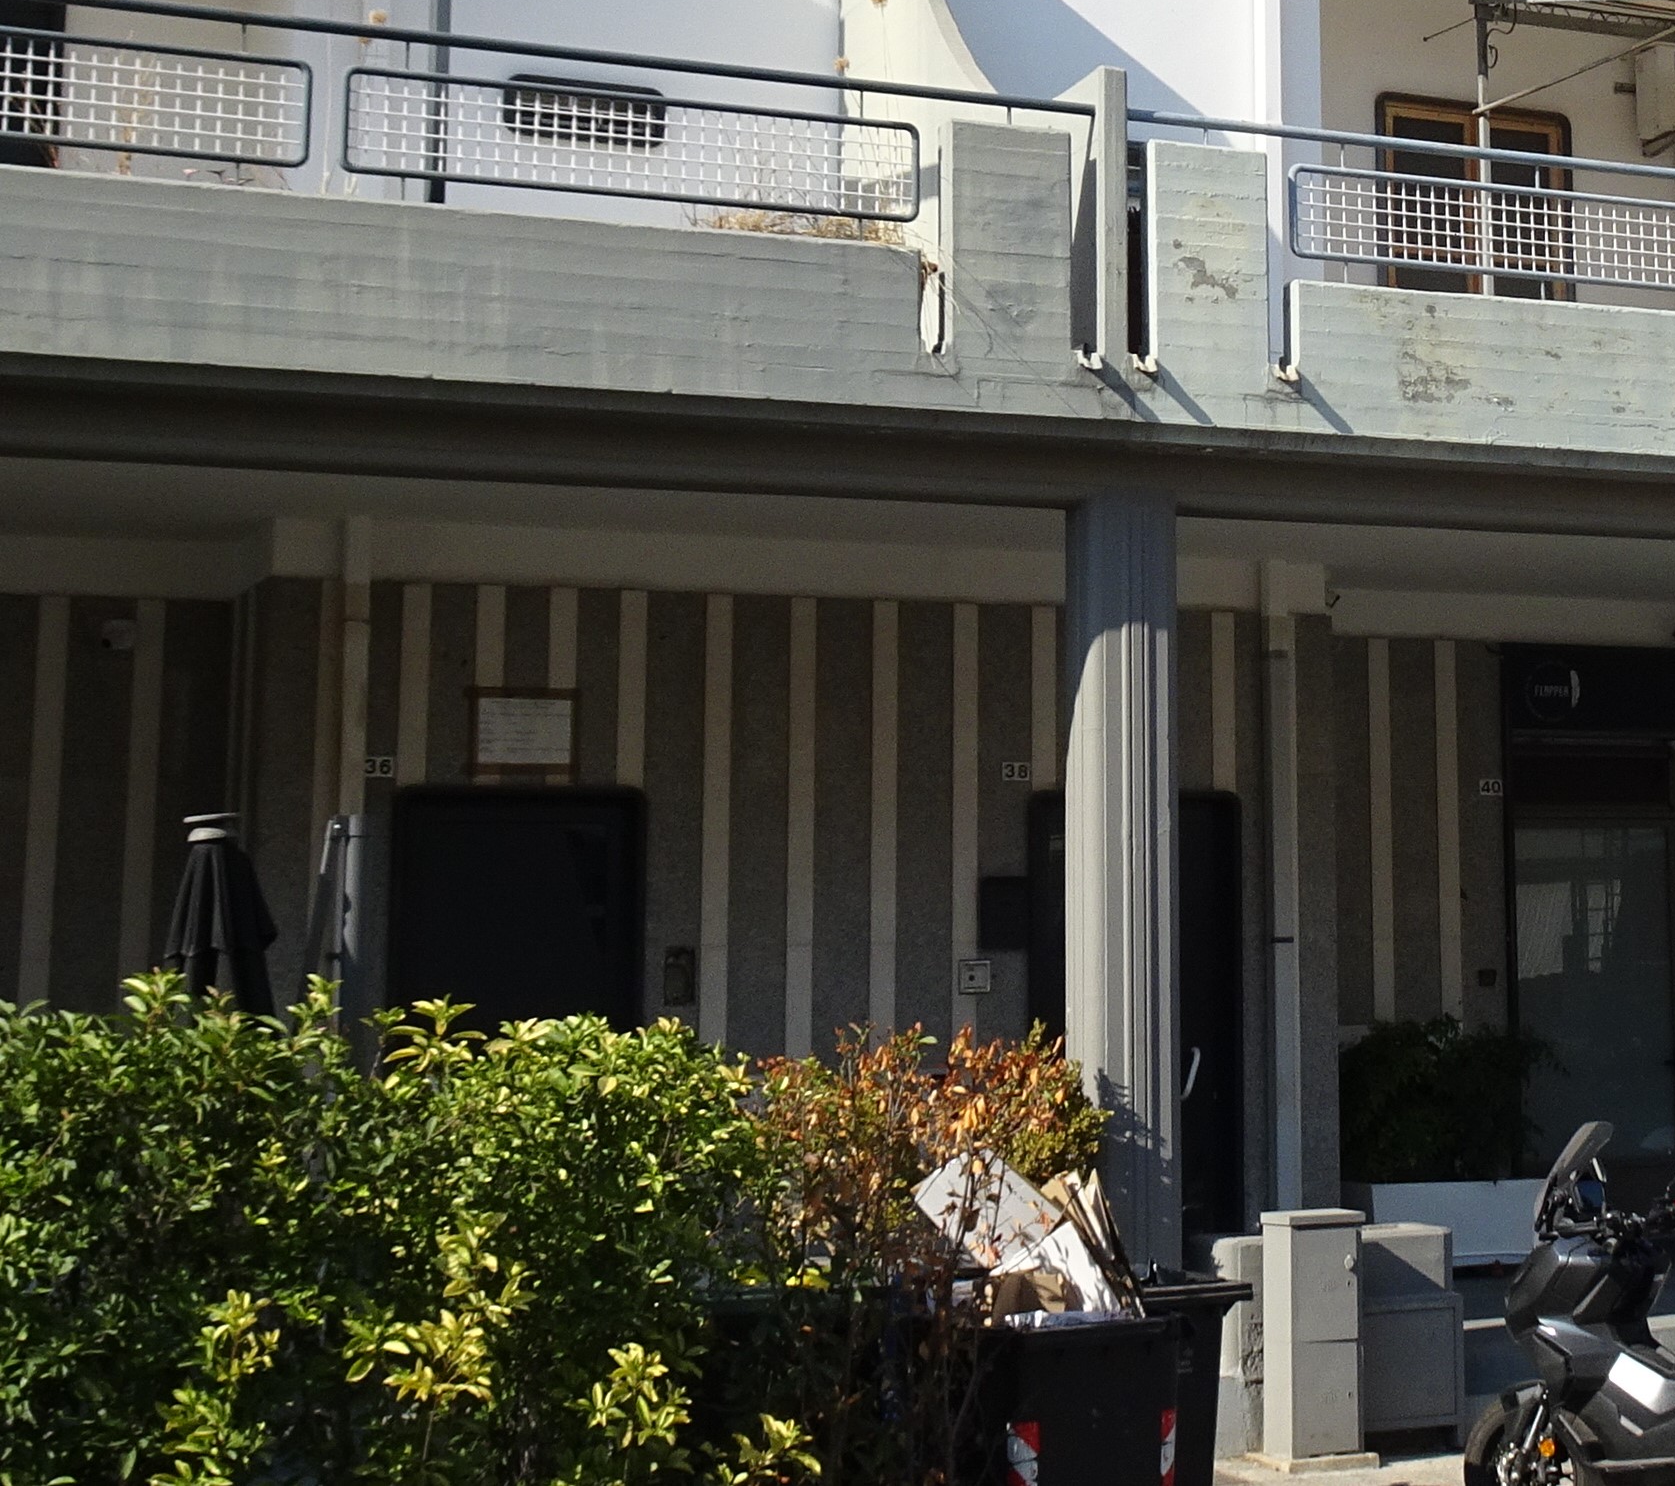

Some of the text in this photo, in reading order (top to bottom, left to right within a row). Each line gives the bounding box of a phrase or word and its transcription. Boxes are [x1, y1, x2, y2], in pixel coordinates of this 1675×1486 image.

[365, 758, 392, 774] 36
[1005, 764, 1028, 778] 38
[1481, 780, 1501, 793] 40
